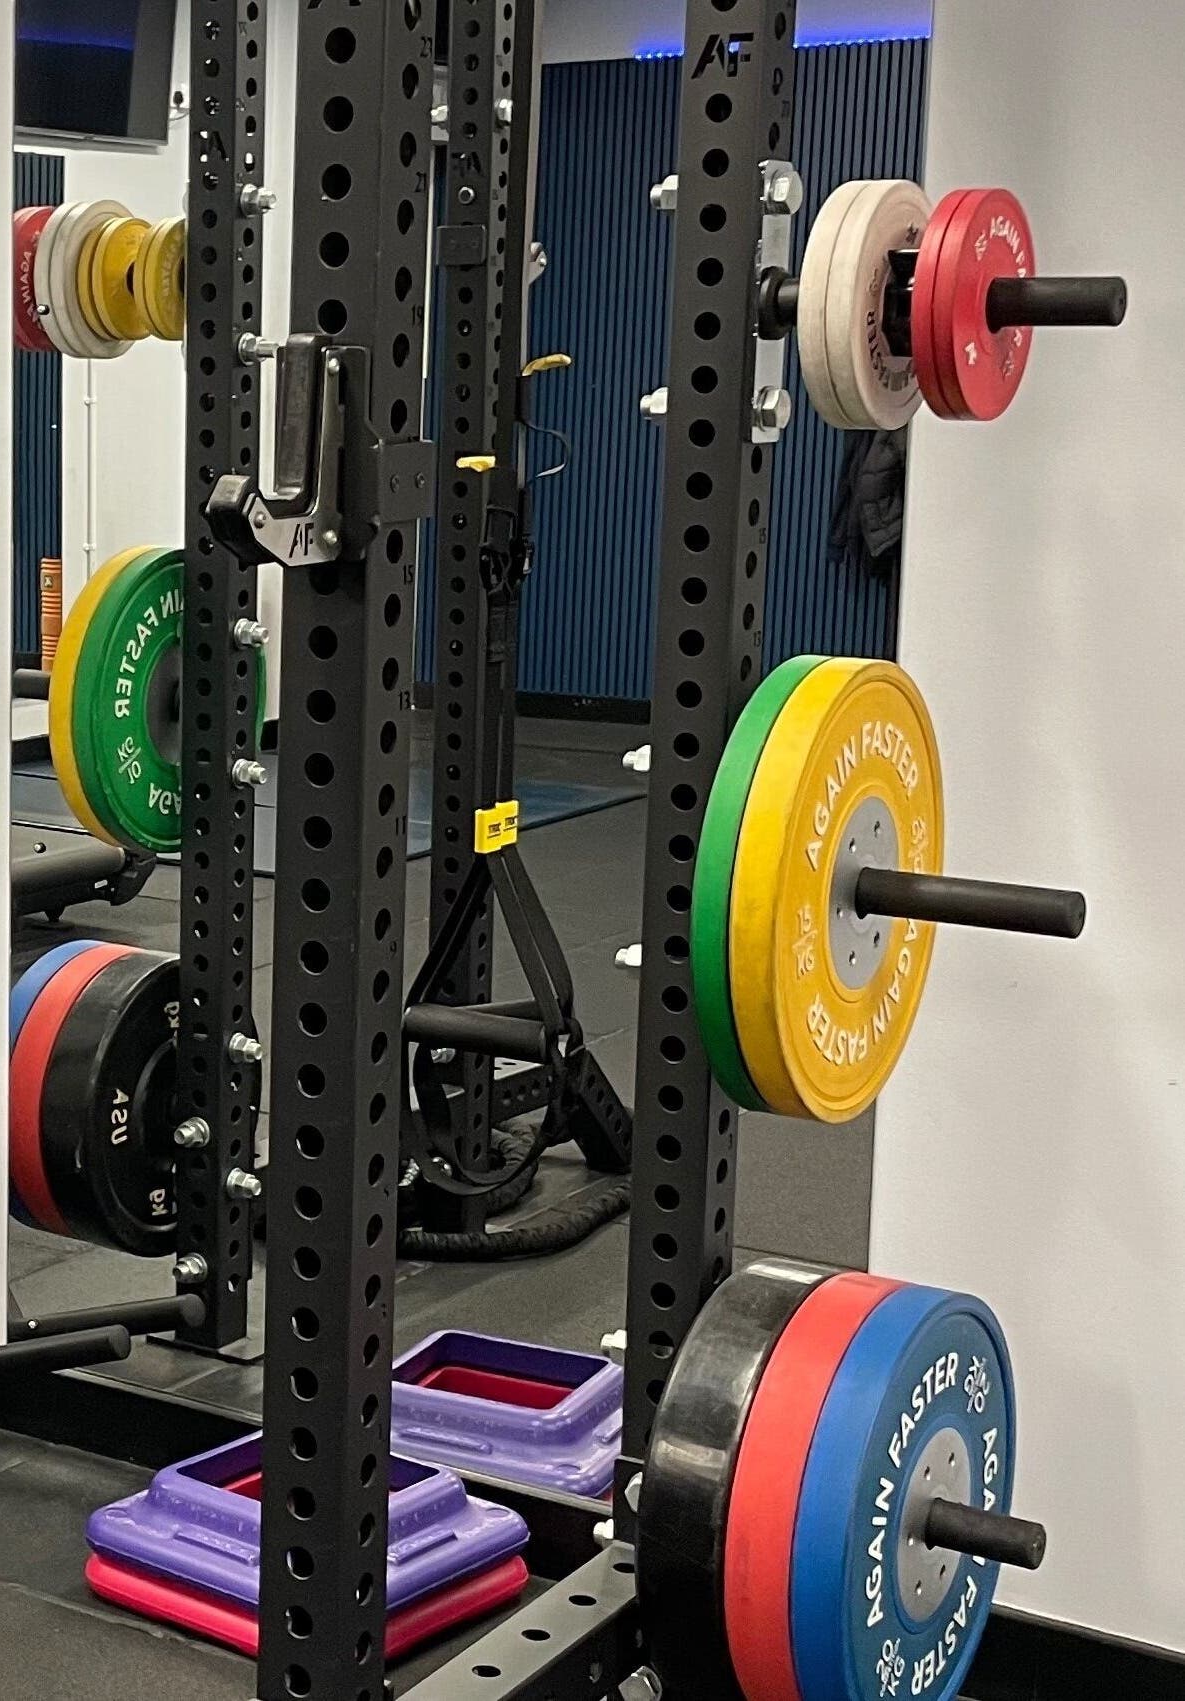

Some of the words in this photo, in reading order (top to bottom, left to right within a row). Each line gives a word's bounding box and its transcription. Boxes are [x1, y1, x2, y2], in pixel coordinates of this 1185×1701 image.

[691, 33, 754, 80] AF
[289, 523, 314, 558] AF
[805, 733, 857, 872] AGAIN
[861, 720, 919, 800] FASTER
[806, 993, 868, 1066] FASTER
[864, 1477, 897, 1629] AGAIN
[887, 1351, 959, 1469] FASTER
[911, 1575, 977, 1695] FASTER
